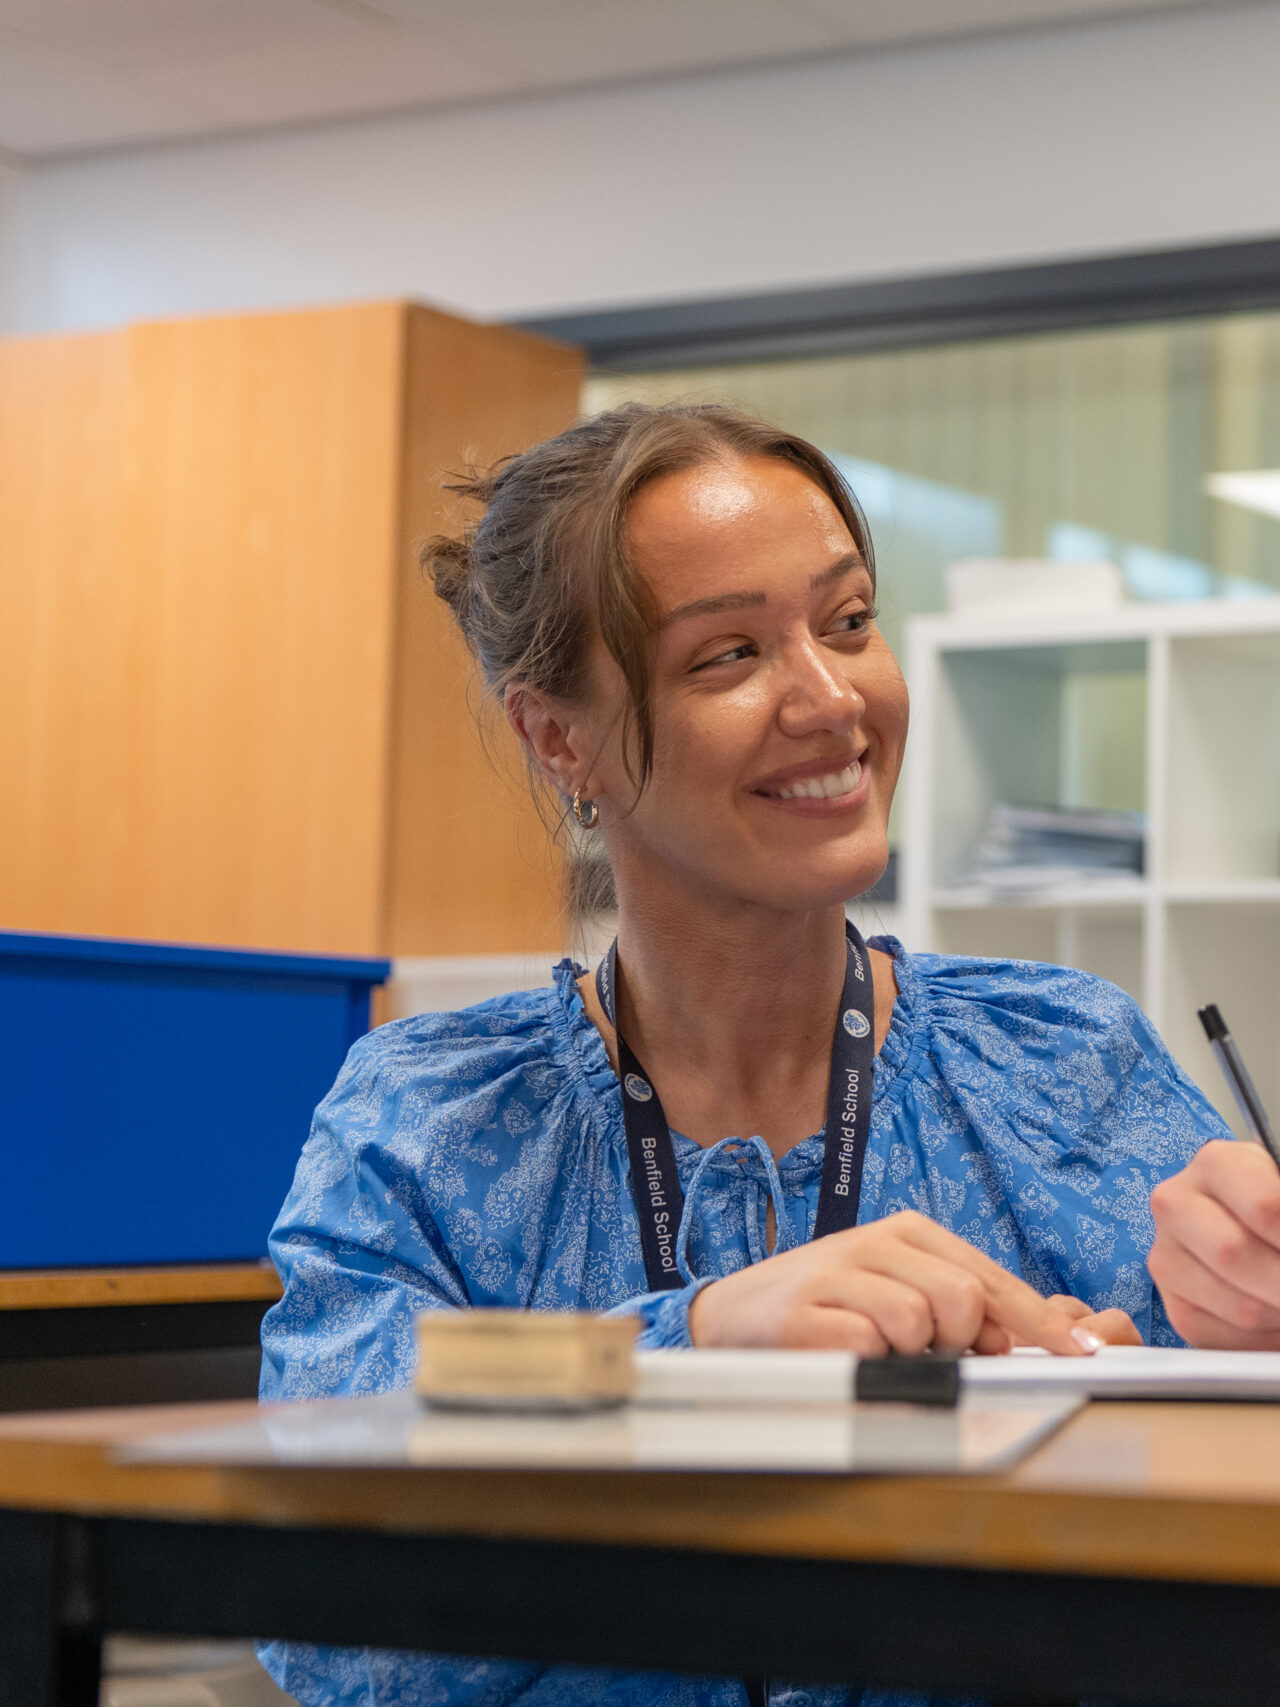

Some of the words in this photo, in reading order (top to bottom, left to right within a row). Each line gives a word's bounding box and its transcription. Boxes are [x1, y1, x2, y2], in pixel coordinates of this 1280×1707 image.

[842, 1068, 860, 1123] School
[834, 1127, 855, 1197] Benfield
[641, 1137, 667, 1207] Benfield
[654, 1211, 678, 1273] School
